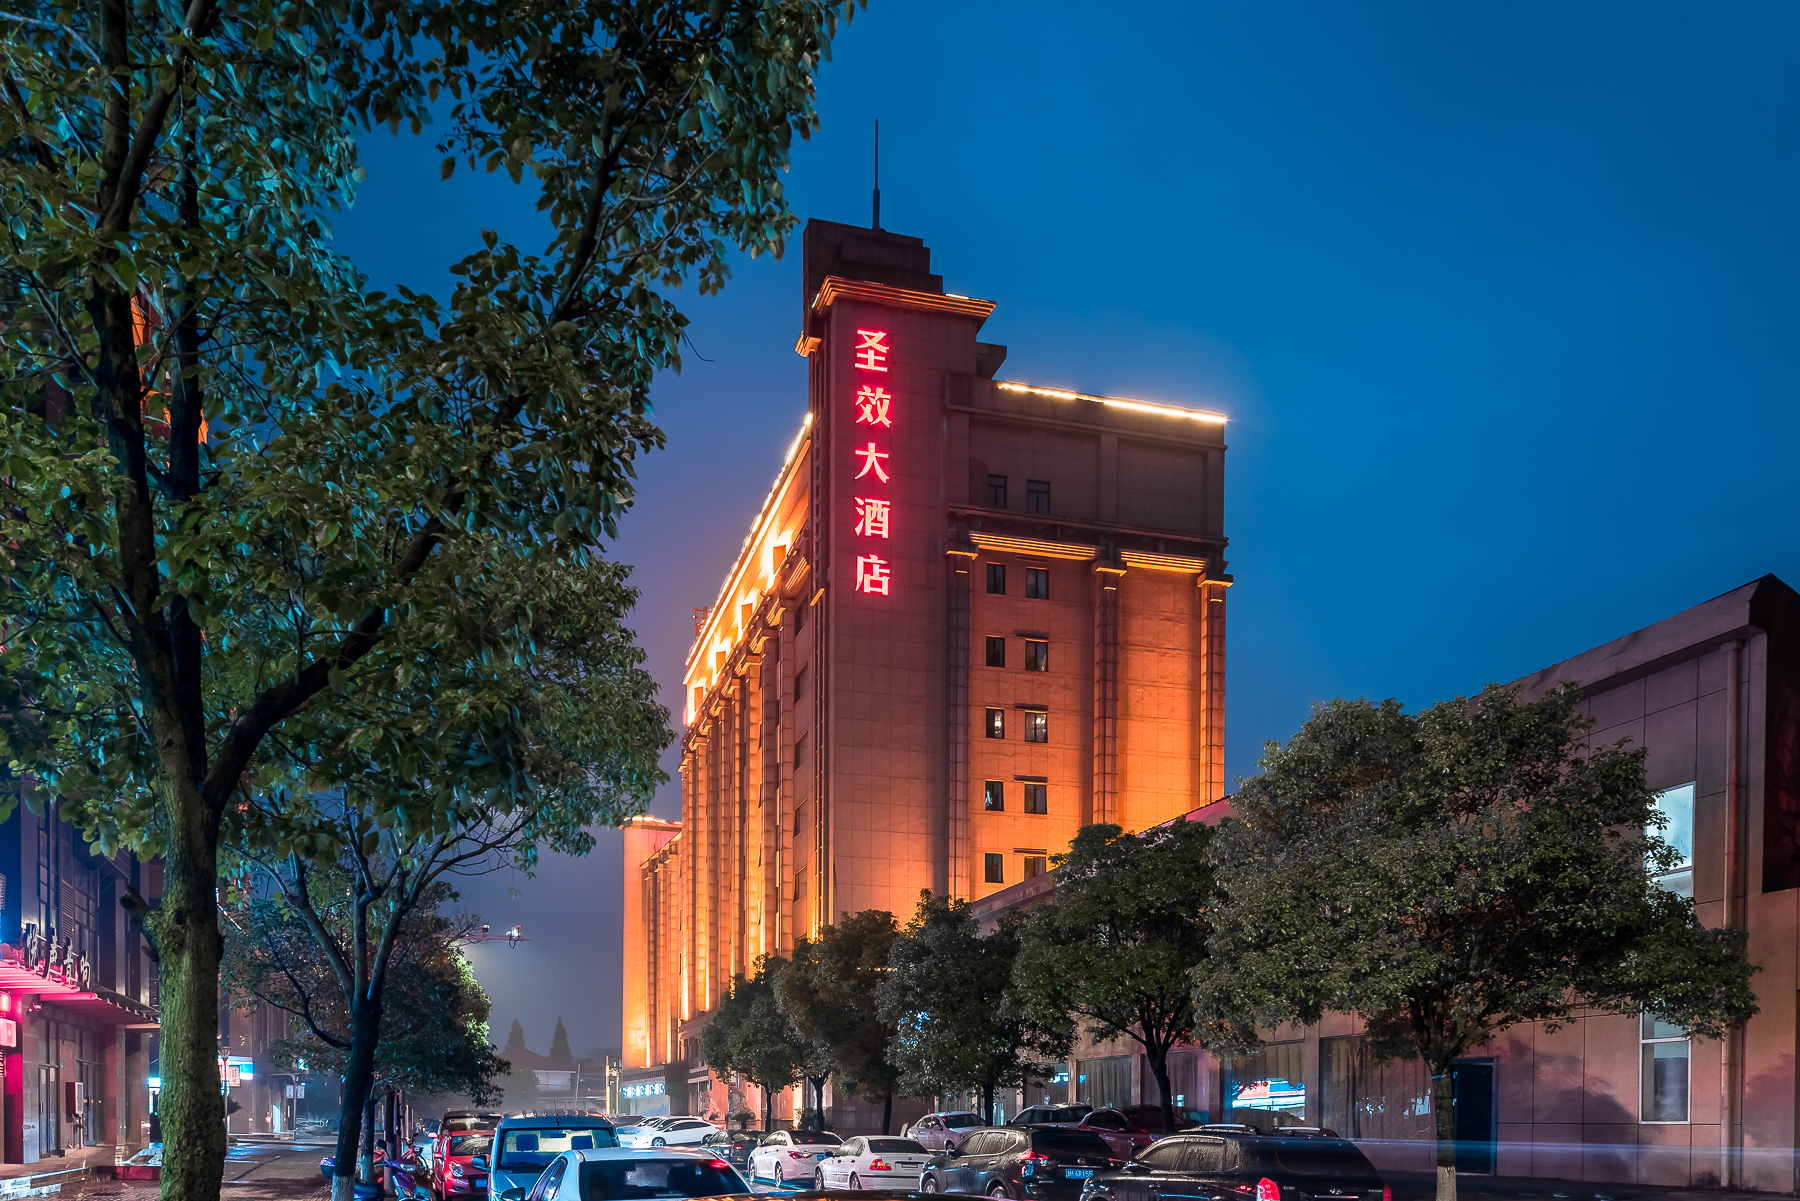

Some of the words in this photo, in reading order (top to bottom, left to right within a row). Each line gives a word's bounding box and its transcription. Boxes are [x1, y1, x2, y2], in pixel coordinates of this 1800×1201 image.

[854, 329, 893, 596] 圣效大酒店
